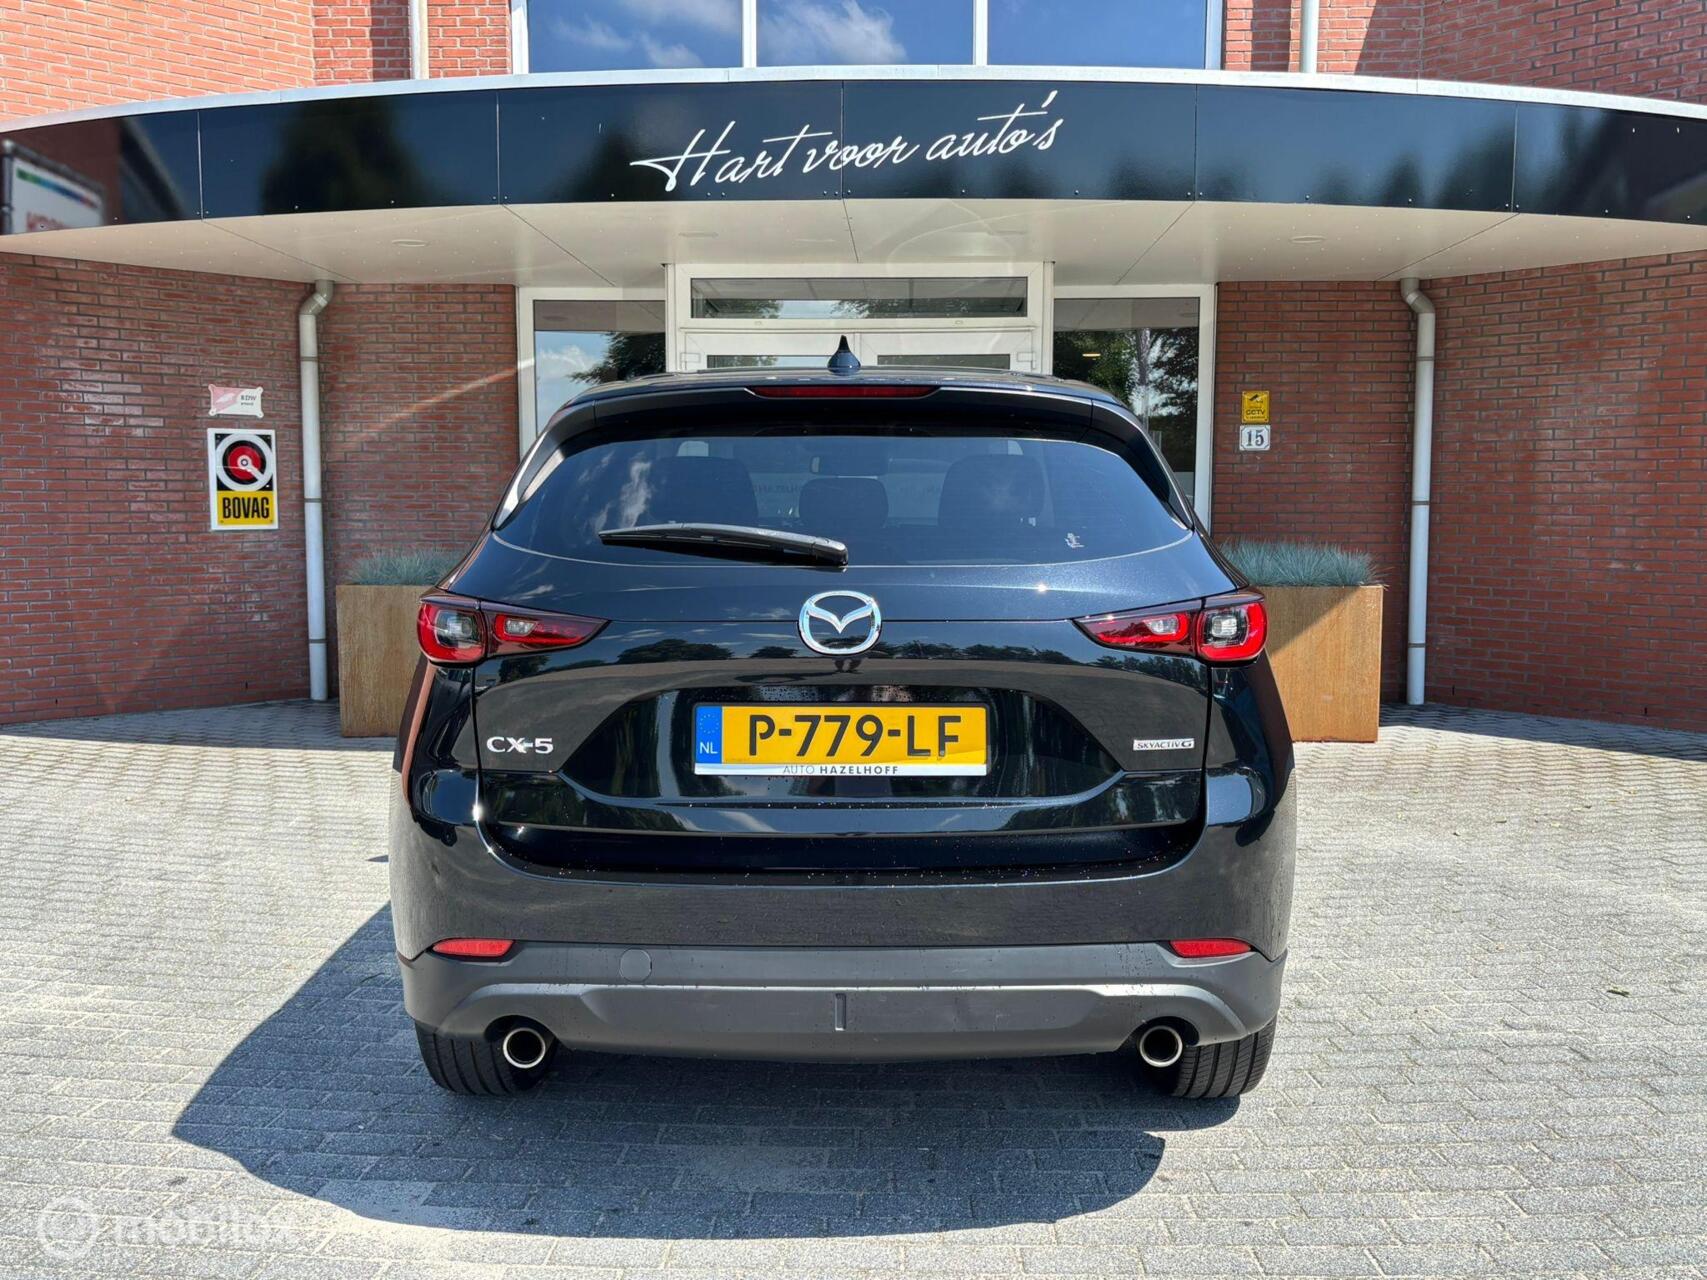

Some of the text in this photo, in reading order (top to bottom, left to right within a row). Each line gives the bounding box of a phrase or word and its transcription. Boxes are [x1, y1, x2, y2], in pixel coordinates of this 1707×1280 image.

[630, 90, 1064, 191] Hart voor auto's
[1246, 429, 1265, 447] 15
[222, 496, 270, 519] BOVAG
[486, 736, 554, 755] CX-5
[748, 714, 962, 758] P-779-LF
[699, 741, 718, 754] NL
[782, 765, 899, 775] AUTO HAZELHOFF
